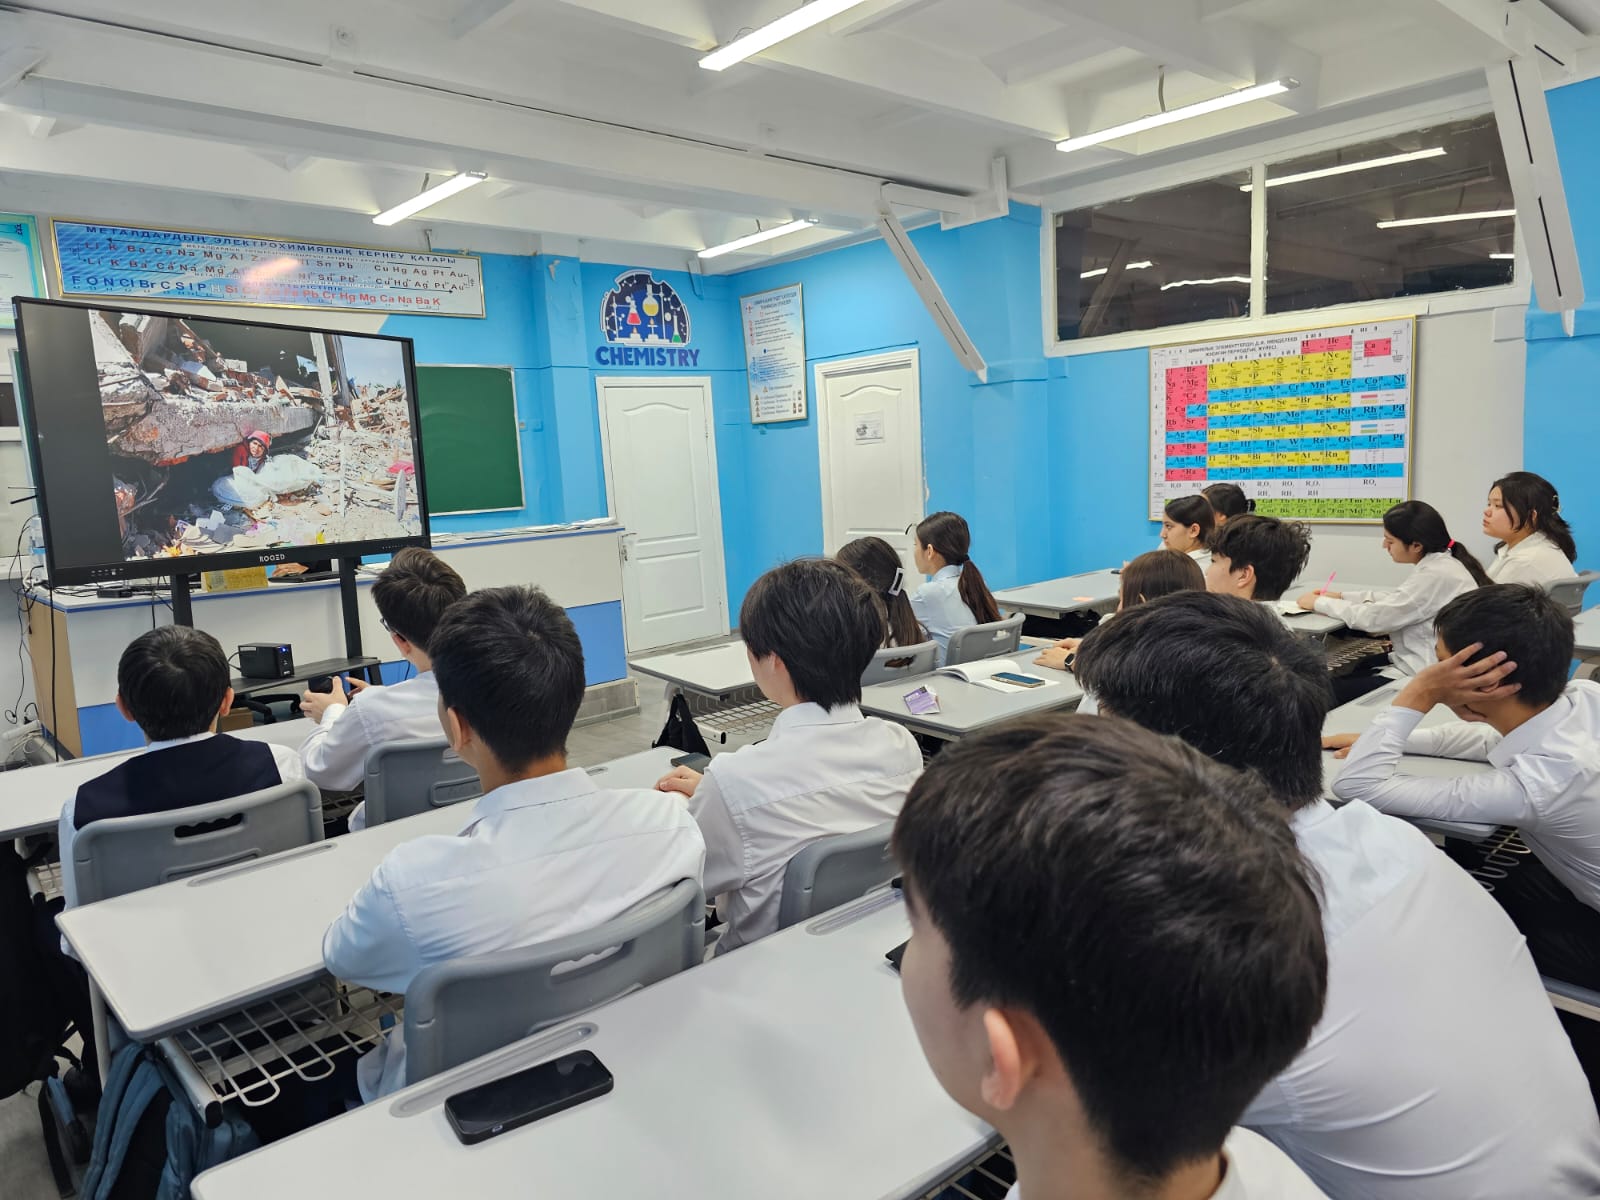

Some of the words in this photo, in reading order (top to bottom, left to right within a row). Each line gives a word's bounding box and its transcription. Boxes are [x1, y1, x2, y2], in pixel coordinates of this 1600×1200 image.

[358, 250, 405, 260] КЕРНЕУ
[72, 276, 80, 285] F
[86, 276, 98, 285] O
[104, 277, 114, 286] N
[140, 280, 156, 288] Br
[161, 281, 170, 289] C
[176, 282, 185, 290] S
[198, 283, 206, 291] P
[340, 292, 356, 302] Hg
[360, 294, 376, 303] Mg
[380, 294, 394, 303] Ca
[595, 346, 700, 367] CHEMISTRY
[1365, 377, 1378, 385] Co
[1393, 374, 1405, 382] Ni
[1363, 406, 1377, 414] Rh
[1392, 404, 1405, 412] Pd
